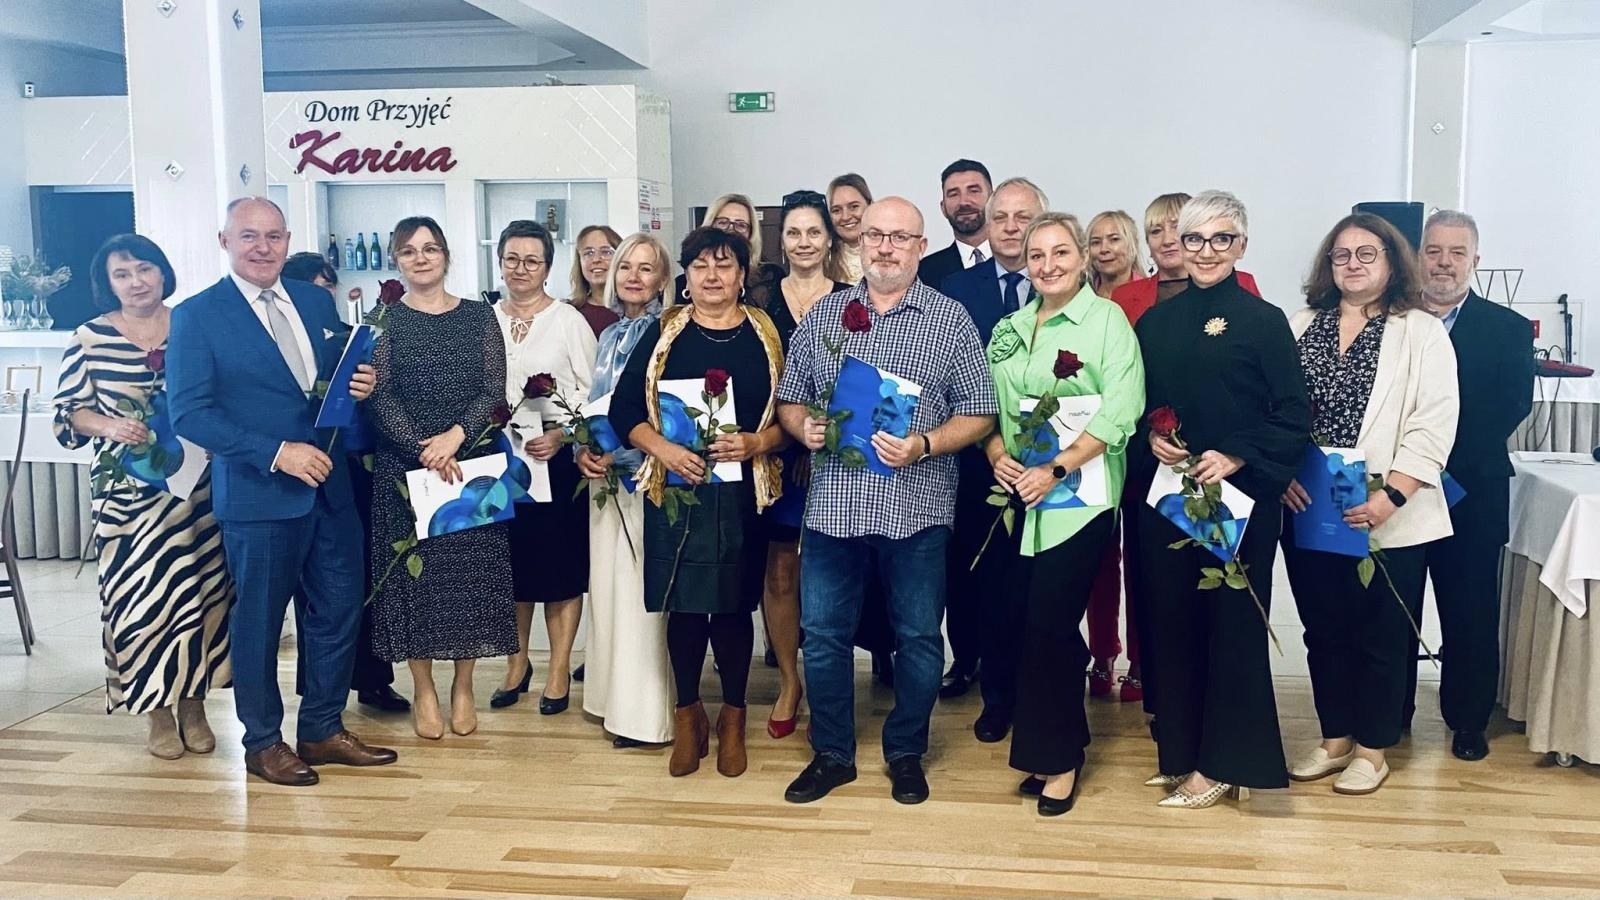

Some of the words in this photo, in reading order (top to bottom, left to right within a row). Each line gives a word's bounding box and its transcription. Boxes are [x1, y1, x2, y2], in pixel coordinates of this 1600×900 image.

[304, 100, 360, 122] Dom
[366, 96, 452, 128] Przyjęć
[289, 129, 458, 175] Karina
